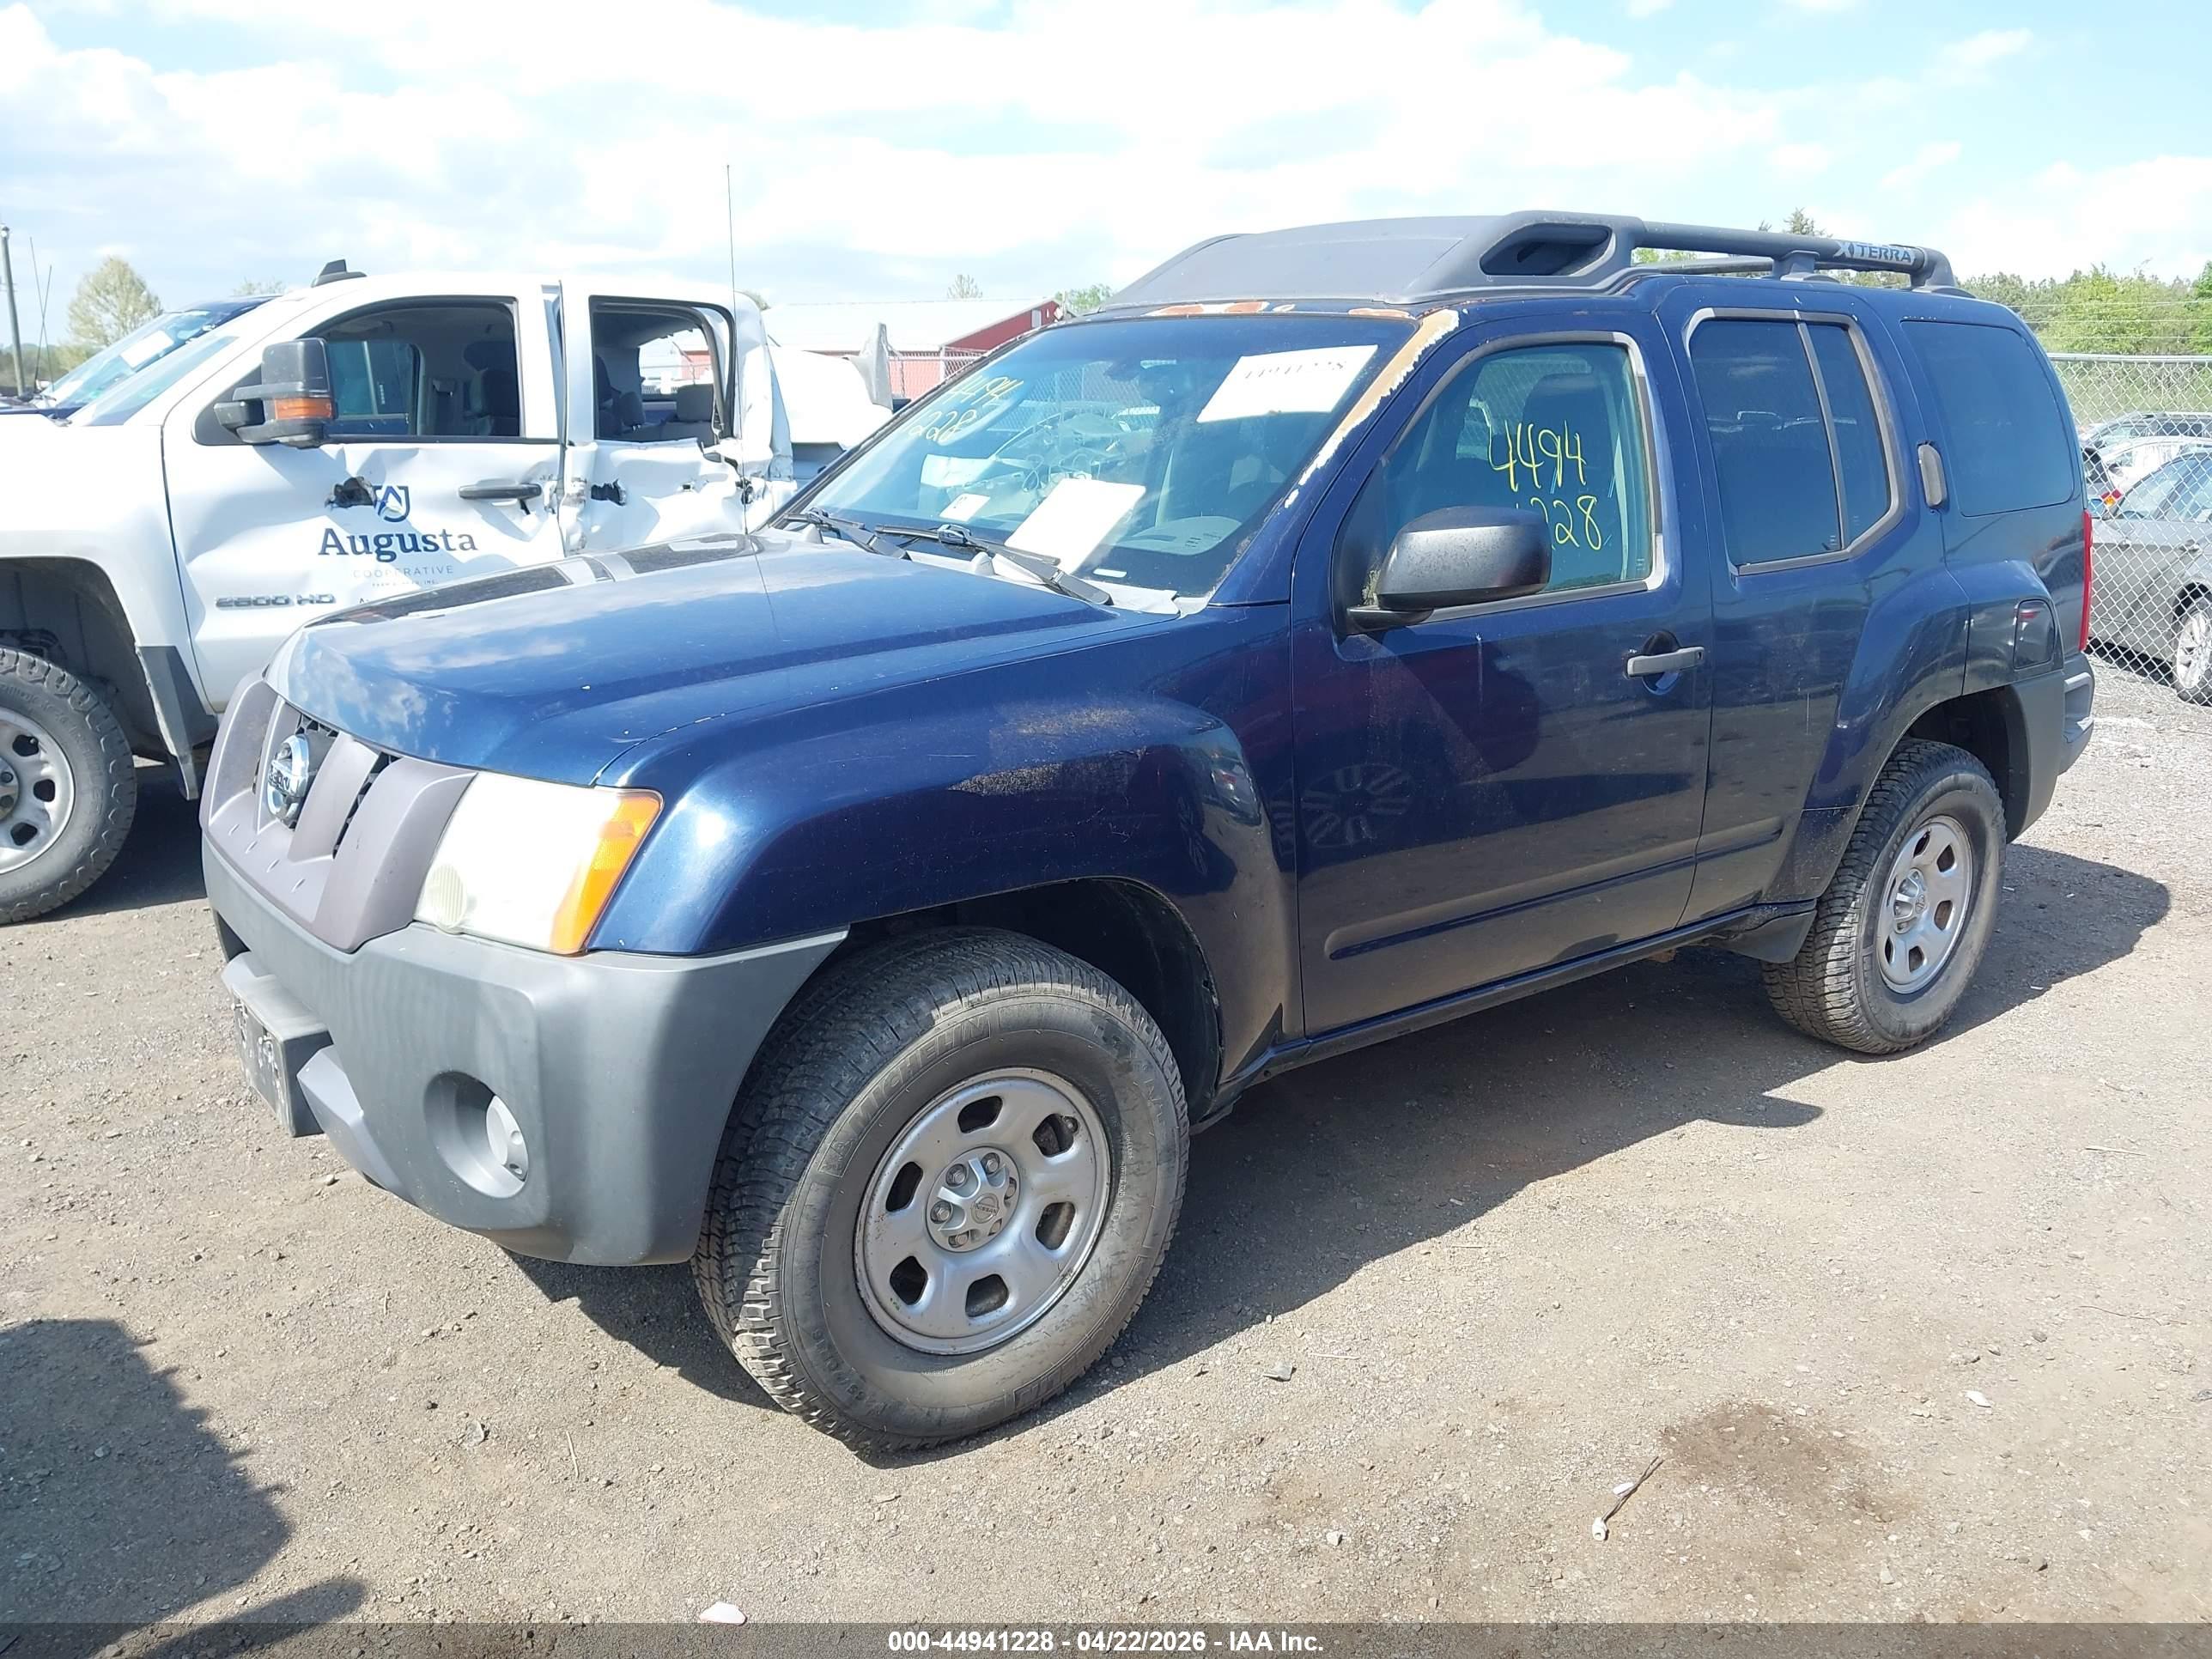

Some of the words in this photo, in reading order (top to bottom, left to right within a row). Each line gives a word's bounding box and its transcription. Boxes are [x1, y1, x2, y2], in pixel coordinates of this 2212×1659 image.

[1832, 240, 1912, 263] XTERRA
[1488, 419, 1587, 492] 4494
[318, 528, 478, 562] Augusta
